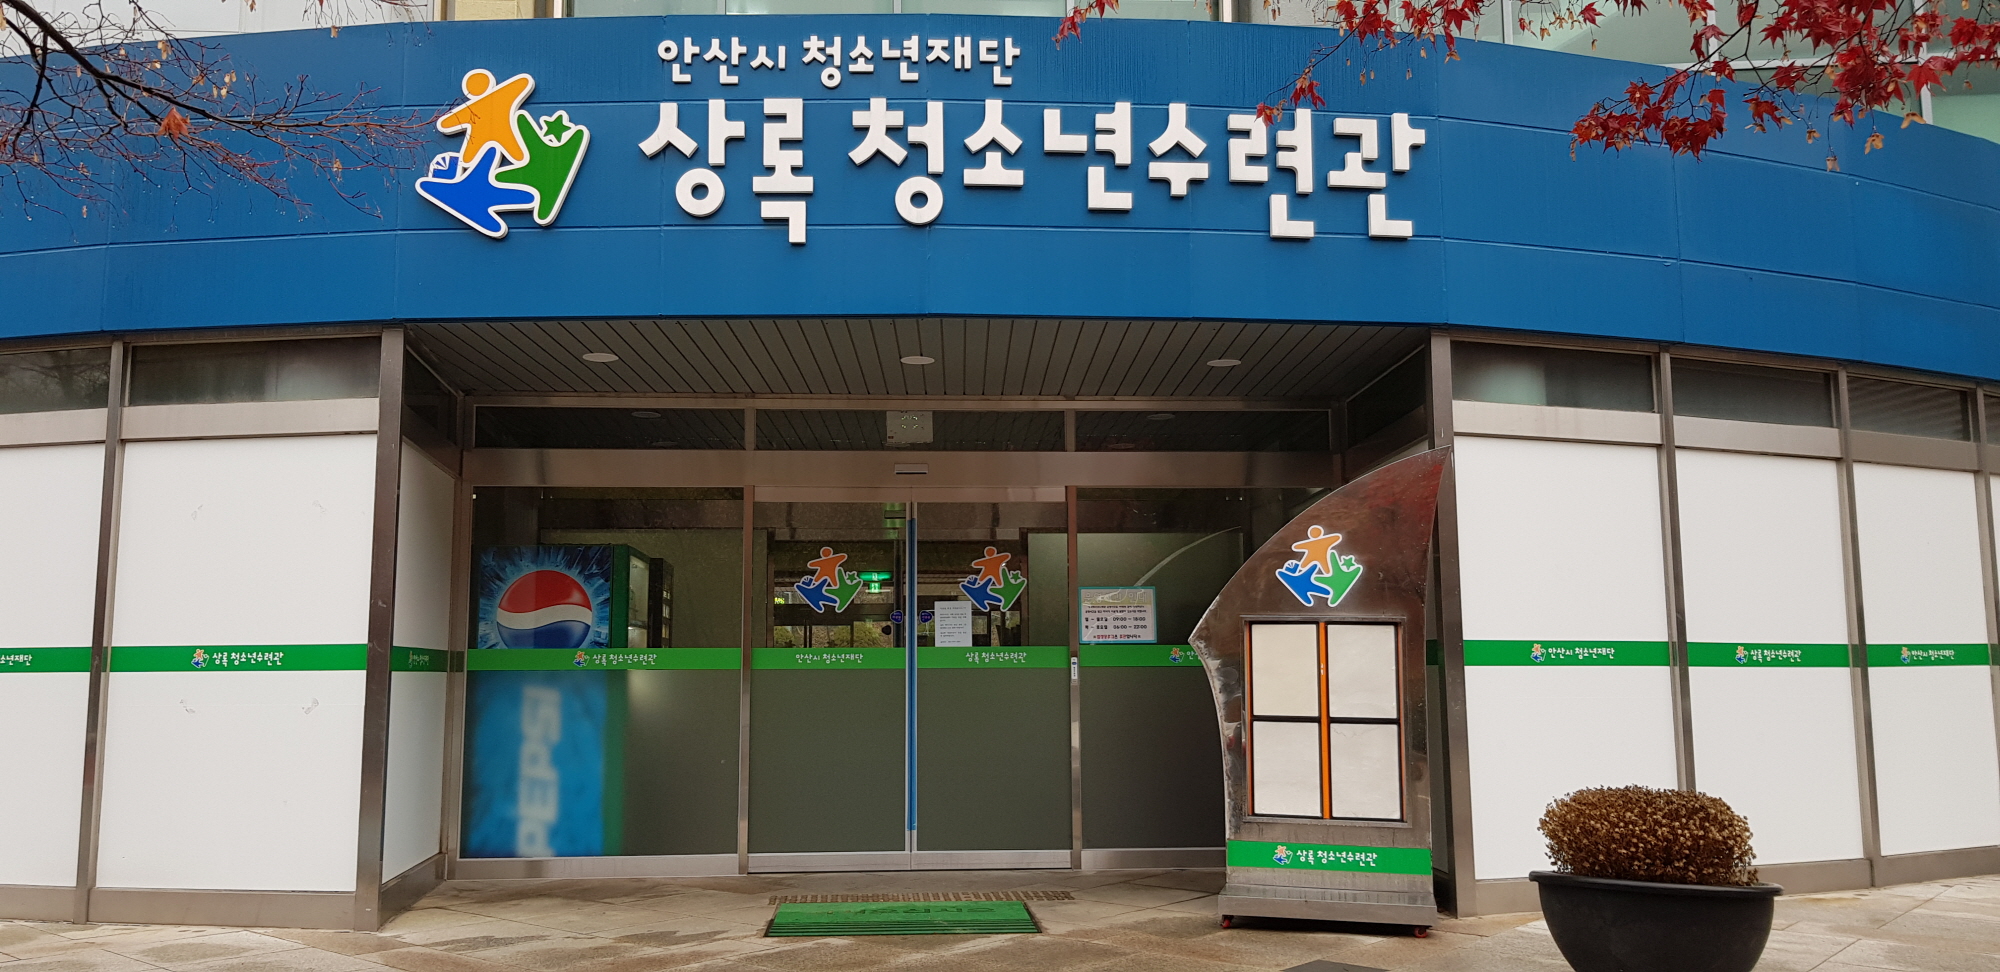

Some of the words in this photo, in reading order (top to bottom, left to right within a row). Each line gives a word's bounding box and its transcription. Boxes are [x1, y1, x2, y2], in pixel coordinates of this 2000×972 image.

[657, 36, 787, 84] 안산시
[801, 35, 1021, 88] 청소년재단
[638, 97, 814, 244] 상록
[849, 97, 1426, 238] 청소년수련관
[212, 651, 229, 668] 상록
[230, 651, 285, 666] 청소년수련관
[592, 653, 607, 666] 상록
[609, 653, 658, 666] 청소년수련관
[795, 653, 821, 664] 안산시
[823, 653, 864, 664] 청소년재단
[965, 651, 980, 664] 상록
[981, 651, 1027, 663] 청소년수련관
[1547, 647, 1573, 659] 안산시
[1574, 647, 1615, 660] 청소년재단
[1750, 649, 1763, 664] 상록
[1763, 649, 1802, 663] 청소년수련관
[1911, 649, 1928, 660] 안산시
[1928, 649, 1955, 661] 청소년재단
[514, 684, 562, 858] PEPSI
[1296, 849, 1315, 866] 상록
[1316, 850, 1378, 867] 청소년수련관
